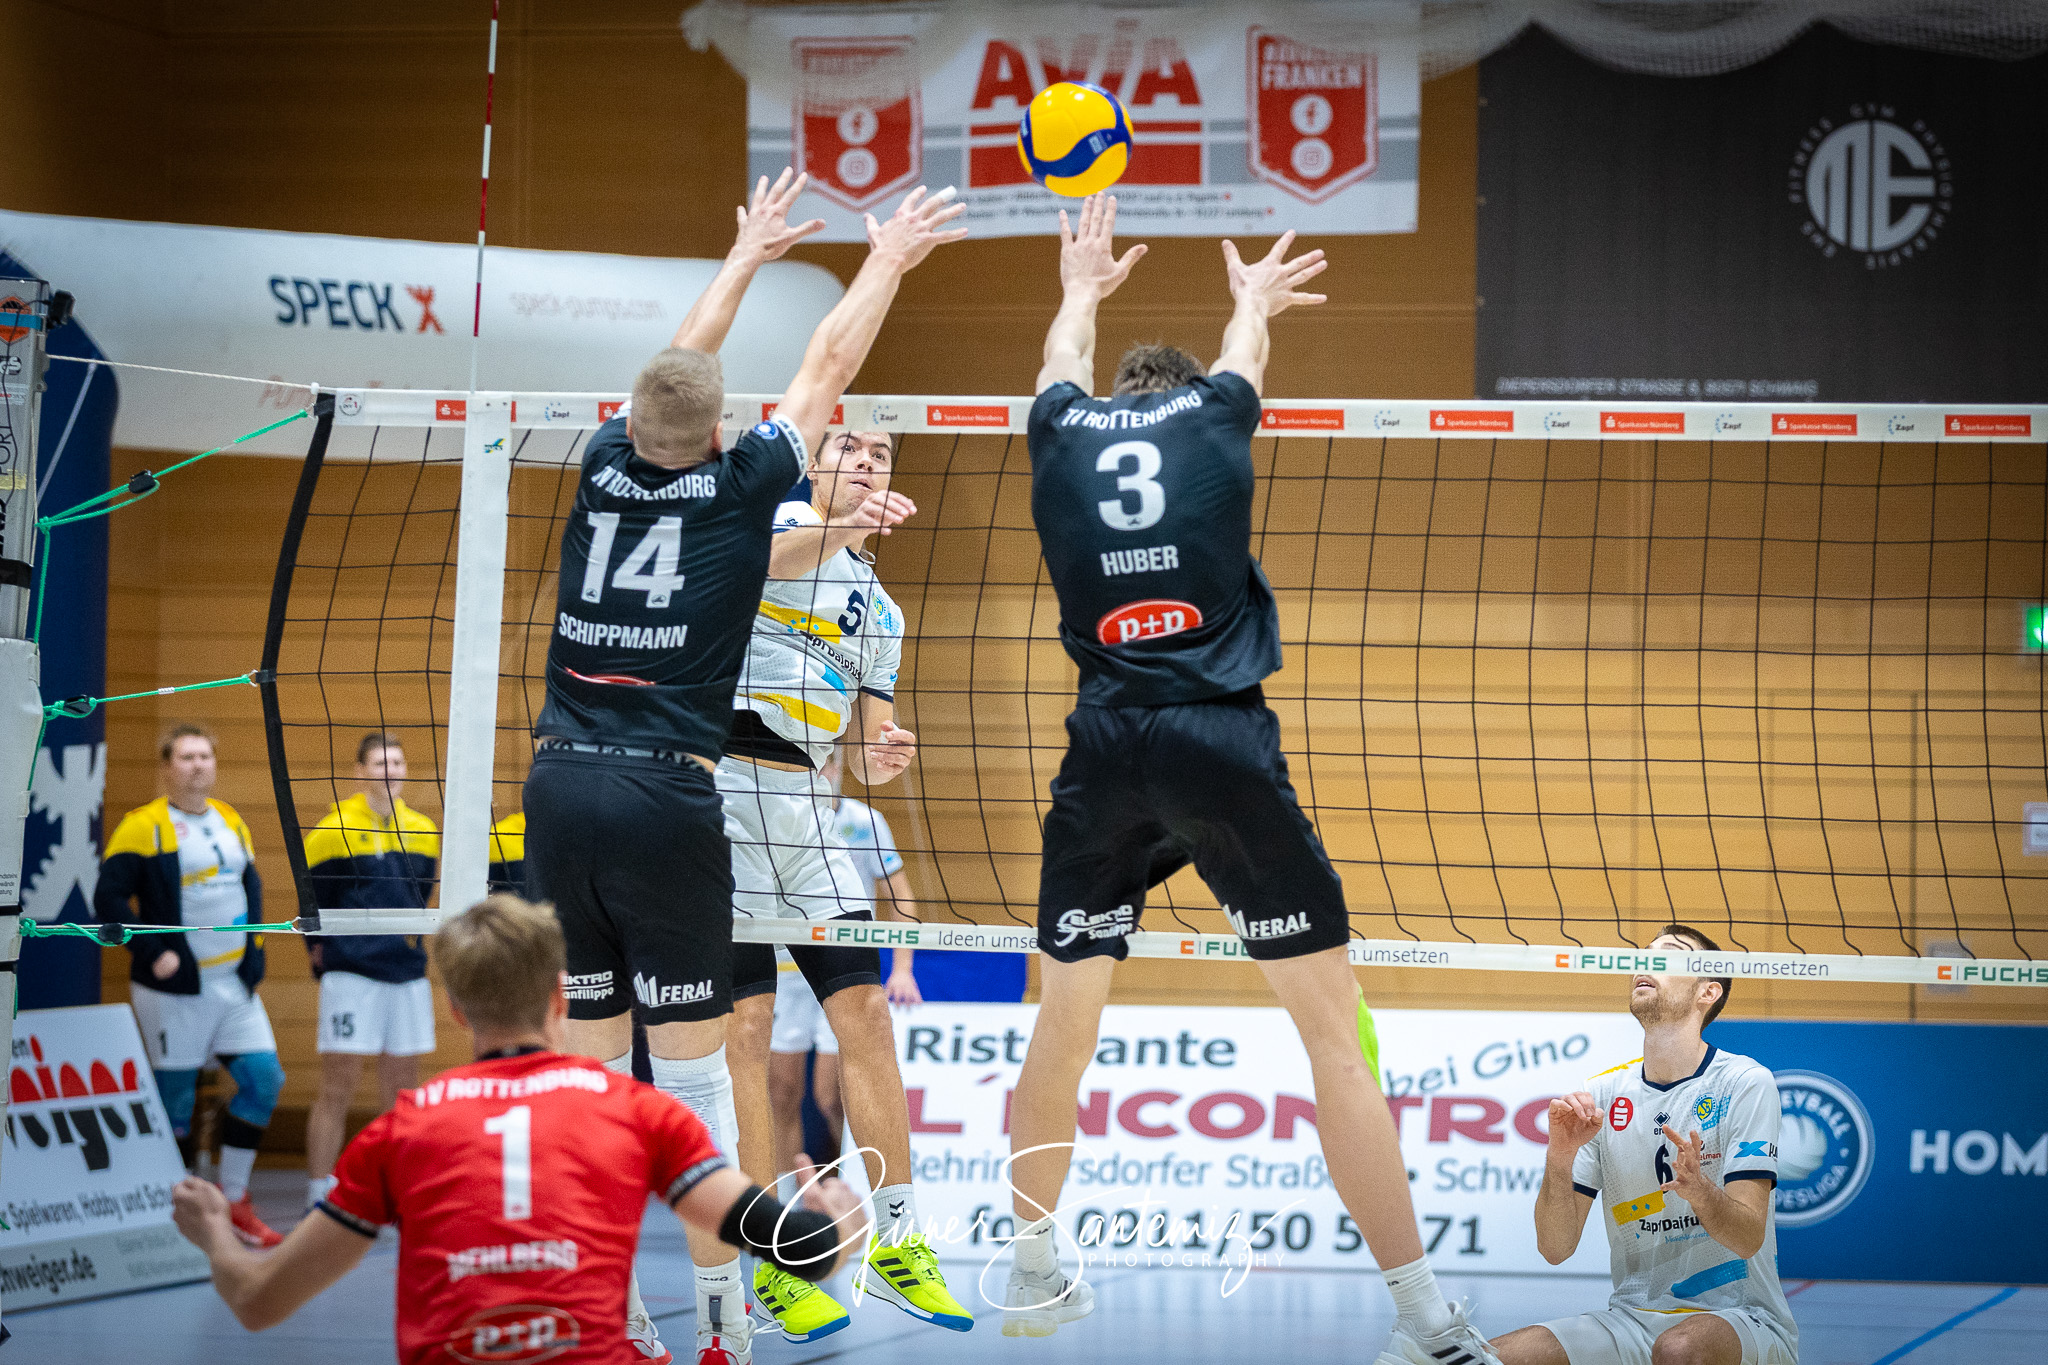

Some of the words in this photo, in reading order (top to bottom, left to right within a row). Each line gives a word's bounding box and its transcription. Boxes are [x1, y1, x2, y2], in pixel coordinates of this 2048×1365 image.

[269, 275, 405, 334] SPECK
[551, 410, 570, 420] Zapf
[879, 413, 898, 423] Zapf
[945, 413, 974, 423] Sparkasse
[1083, 389, 1203, 430] ROTTENBURG
[1278, 417, 1309, 426] Sparkasse
[1381, 417, 1401, 427] Zapf
[1447, 418, 1478, 428] Sparkasse
[1551, 419, 1570, 429] Zapf
[1617, 420, 1649, 430] Sparkasse
[1722, 421, 1742, 431] Zapf
[1789, 422, 1821, 432] Sparkasse
[1895, 423, 1915, 433] Zapf
[1962, 423, 1994, 433] Sparkasse
[1095, 440, 1166, 532] 3
[581, 511, 685, 609] 14
[1100, 545, 1179, 577] HUBER
[838, 589, 867, 636] 5
[558, 612, 688, 650] SCHIPPMANN
[1117, 608, 1185, 643] p+p
[1249, 911, 1312, 937] FERAL
[837, 927, 920, 945] FUCHS
[938, 930, 985, 948] Ideen
[991, 934, 1038, 949] umse
[1363, 948, 1449, 965] umsetzen
[1581, 954, 1667, 972] FUCHS
[1686, 956, 1737, 975] Ideen
[1742, 959, 1829, 977] umsetzen
[562, 970, 613, 986] EKTRO
[1963, 966, 2048, 984] FUCHS
[562, 986, 614, 1001] anfilippo
[660, 979, 714, 1003] FERAL
[331, 1013, 356, 1038] 15
[158, 1031, 168, 1055] 1
[907, 1025, 1236, 1066] Ristante
[1386, 1056, 1458, 1098] bei
[1472, 1033, 1591, 1080] Gino
[415, 1080, 445, 1108] TV
[446, 1067, 609, 1101] ROTTENBURG
[1781, 1089, 1851, 1140] EYBALL
[484, 1105, 532, 1221] 1
[1654, 1143, 1674, 1194] 6
[1776, 1165, 1847, 1210] DESLIGA
[121, 1188, 146, 1214] und
[1639, 1215, 1704, 1235] ZapfDaifu
